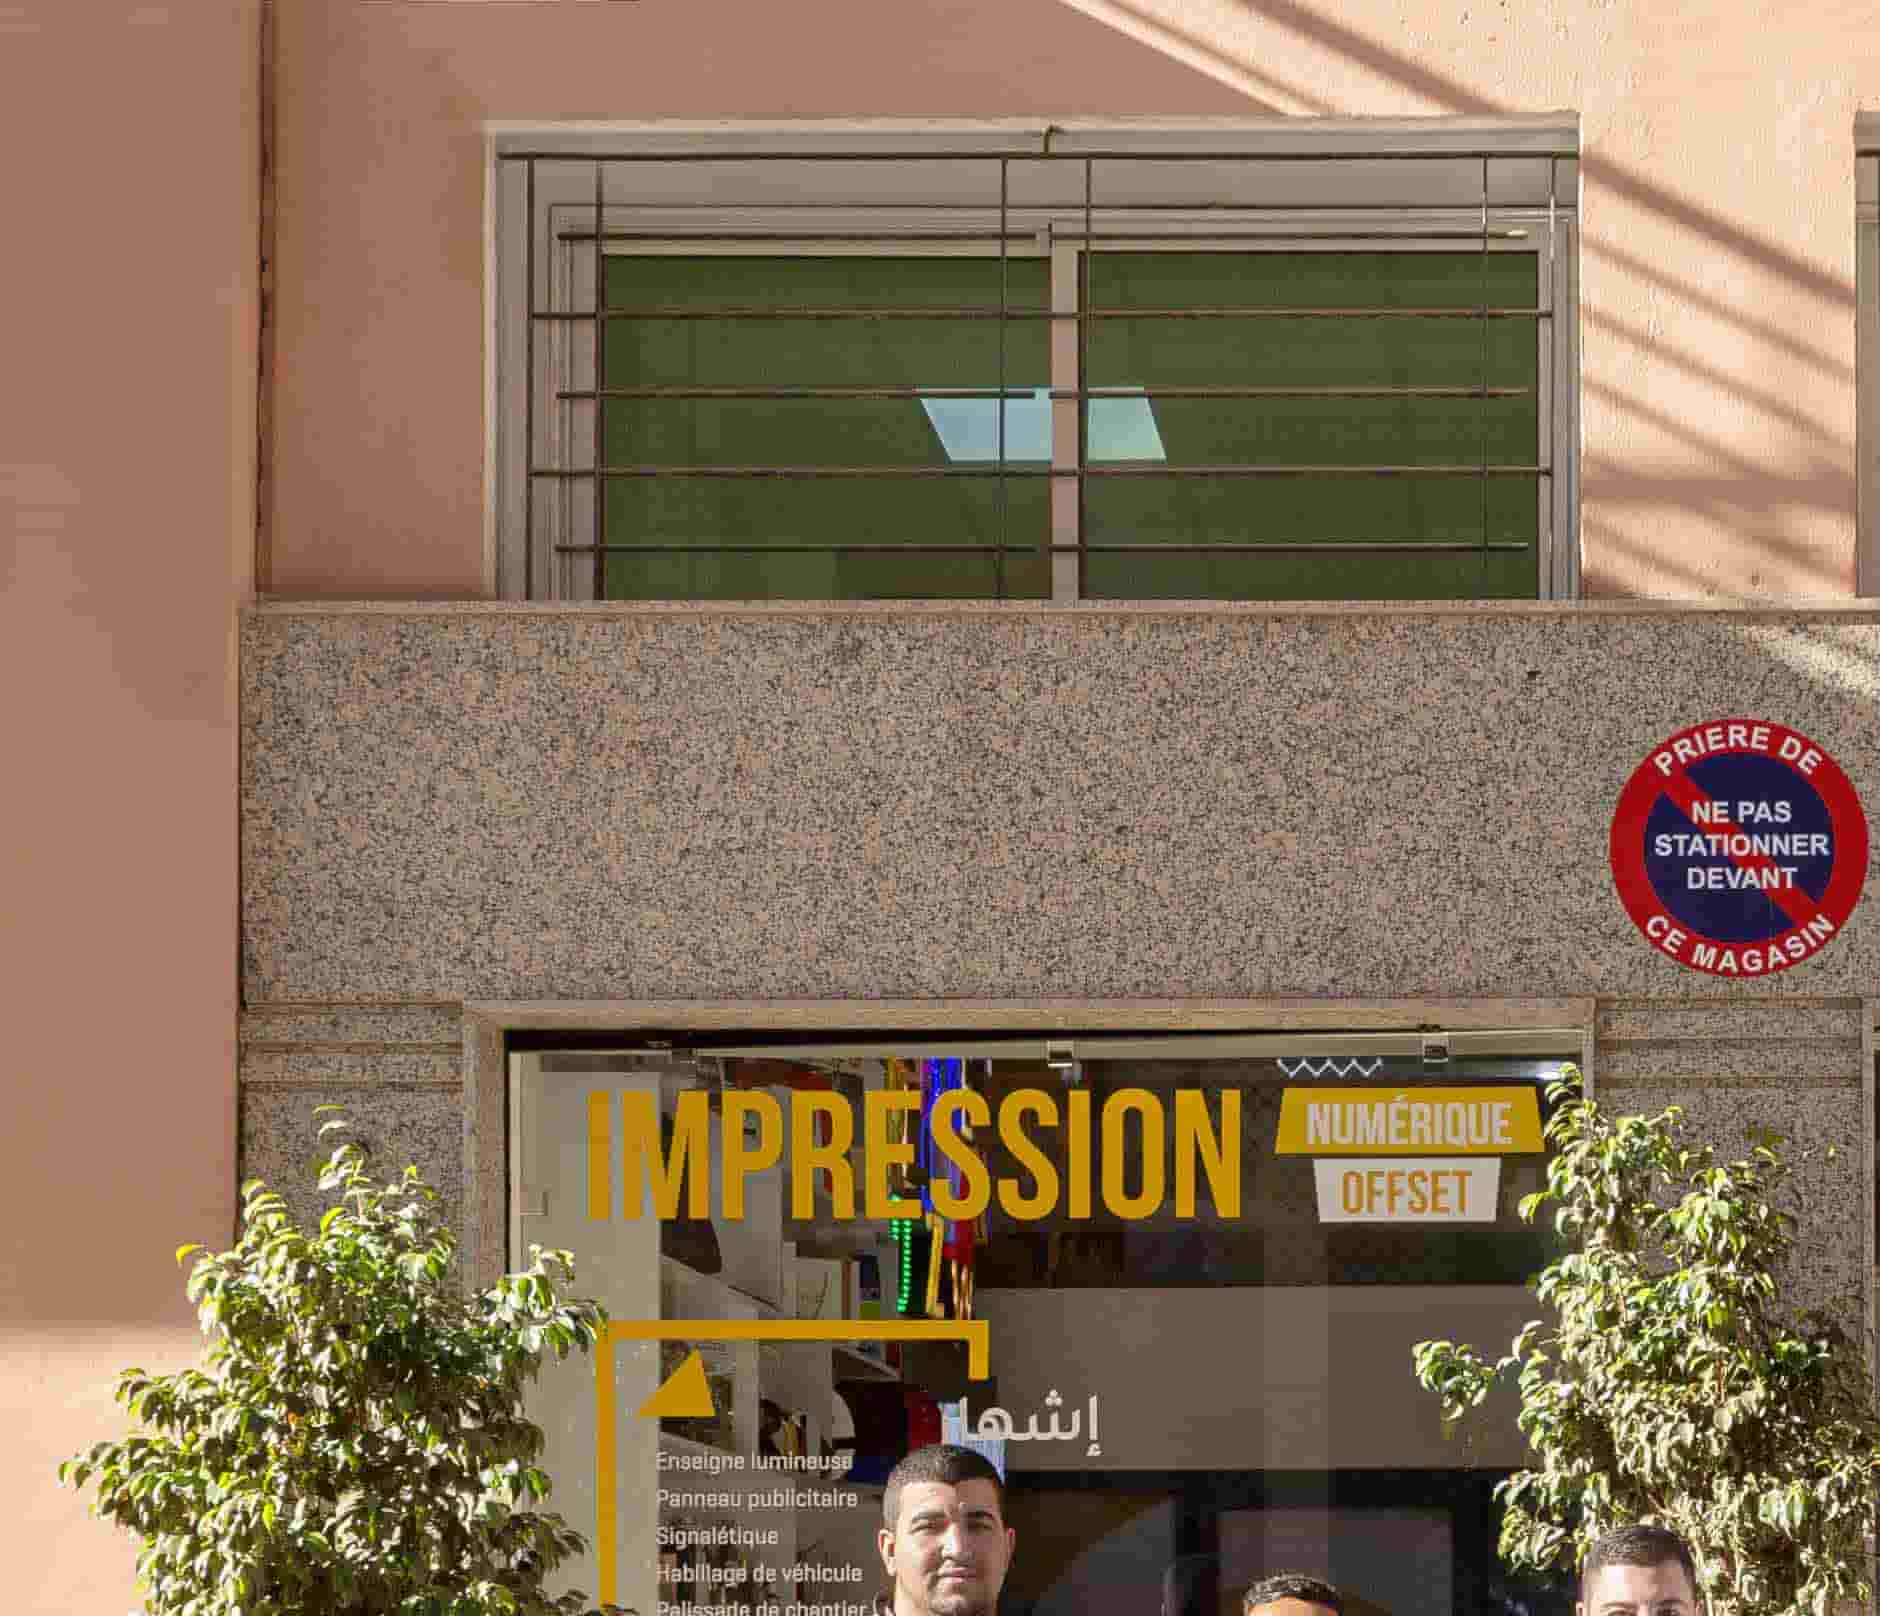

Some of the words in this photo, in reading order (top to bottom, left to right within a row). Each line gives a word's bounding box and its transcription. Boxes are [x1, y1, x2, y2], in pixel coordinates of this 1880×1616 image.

[1655, 724, 1771, 776] PRIERE
[1779, 736, 1823, 775] DE
[1691, 801, 1730, 823] NE
[1738, 801, 1792, 823] PAS
[1655, 833, 1831, 857] STATIONNER
[1687, 867, 1798, 890] DEVANT
[1647, 915, 1687, 953] CE
[1690, 914, 1836, 973] MAGASIN
[1308, 1093, 1512, 1148] NUMÉRIQUE
[586, 1087, 1241, 1221] IMPRESSION
[1342, 1170, 1473, 1215] OFFSET
[656, 1451, 745, 1475] Enseigne
[751, 1451, 854, 1471] lumineuse
[656, 1488, 741, 1507] Panneau
[748, 1488, 858, 1511] publicitaire
[656, 1525, 779, 1550] Signalétique
[656, 1563, 747, 1587] Habillage
[753, 1563, 777, 1583] de
[781, 1563, 864, 1583] véhicule
